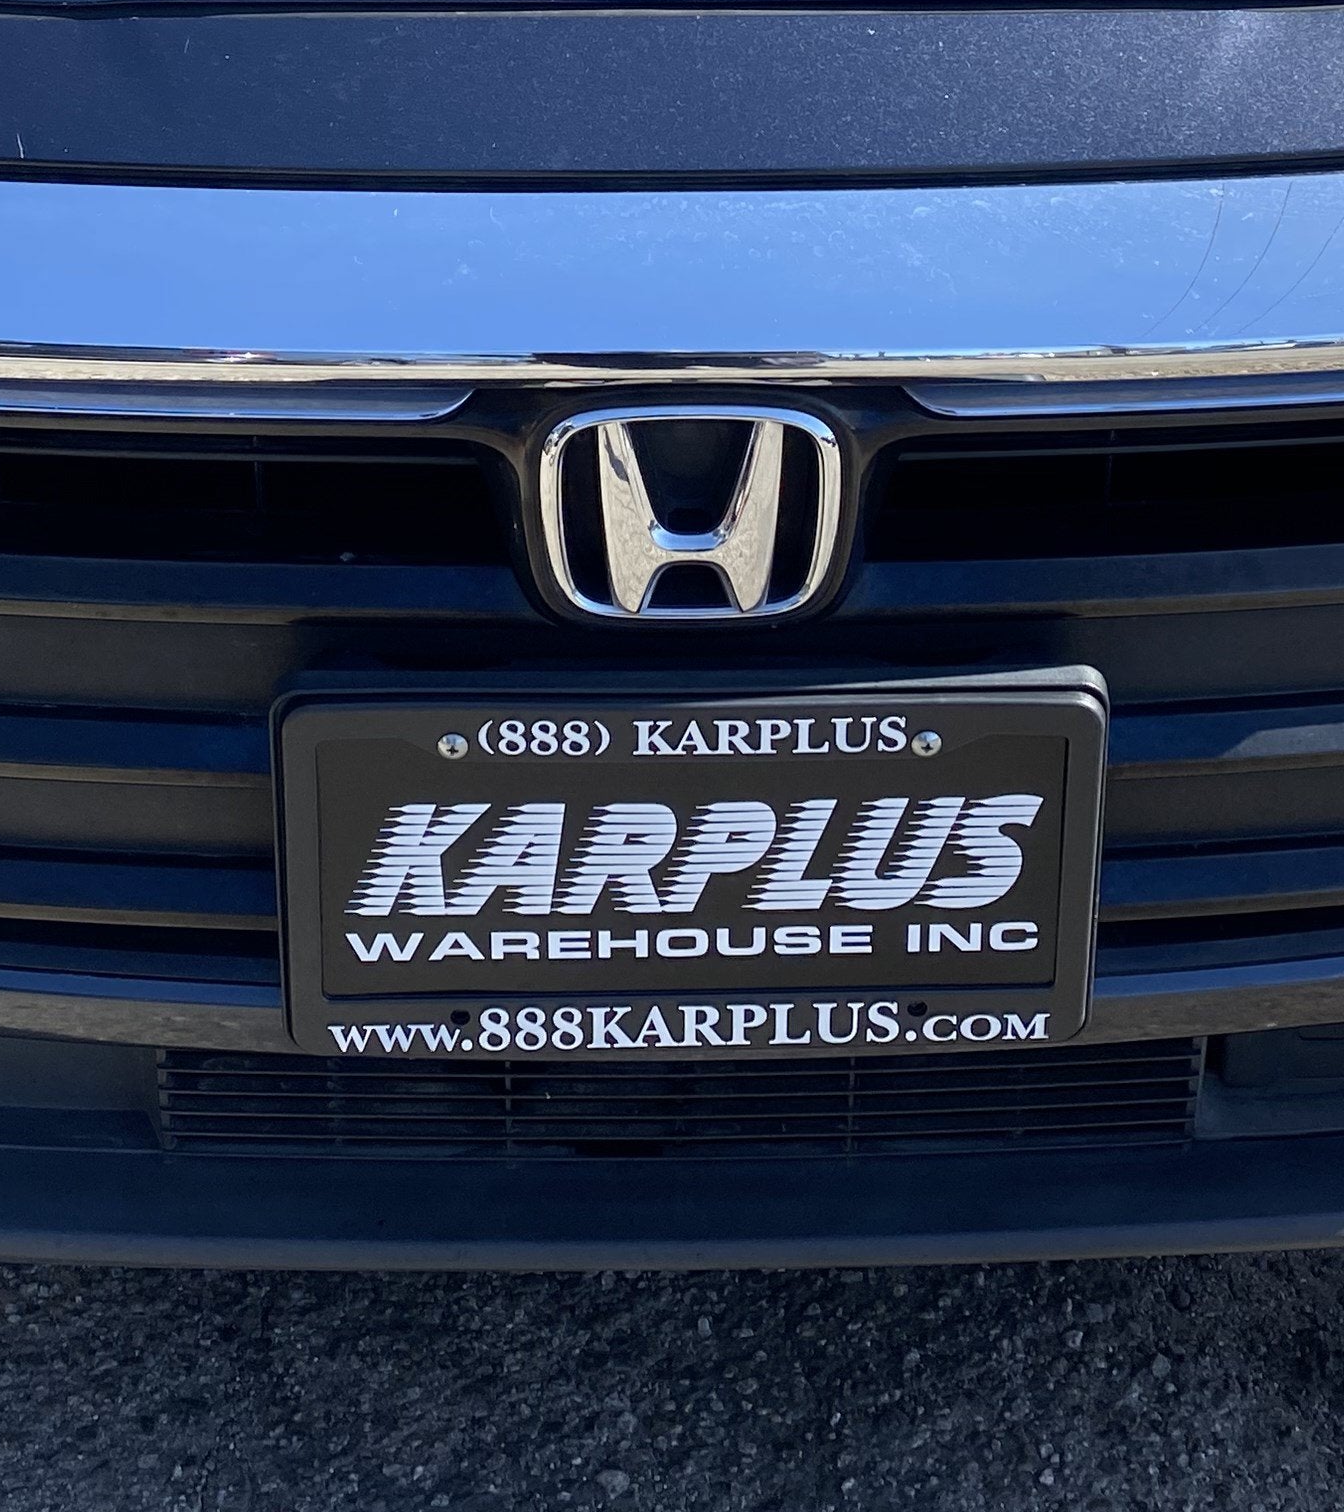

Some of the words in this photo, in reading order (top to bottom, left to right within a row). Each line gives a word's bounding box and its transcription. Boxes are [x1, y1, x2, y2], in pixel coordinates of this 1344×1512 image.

[477, 720, 611, 756] (888)
[632, 716, 907, 755] KARPLUS
[343, 794, 1044, 916] KARPLUS
[345, 924, 873, 963] WAREHOUSE
[907, 921, 1039, 953] INC
